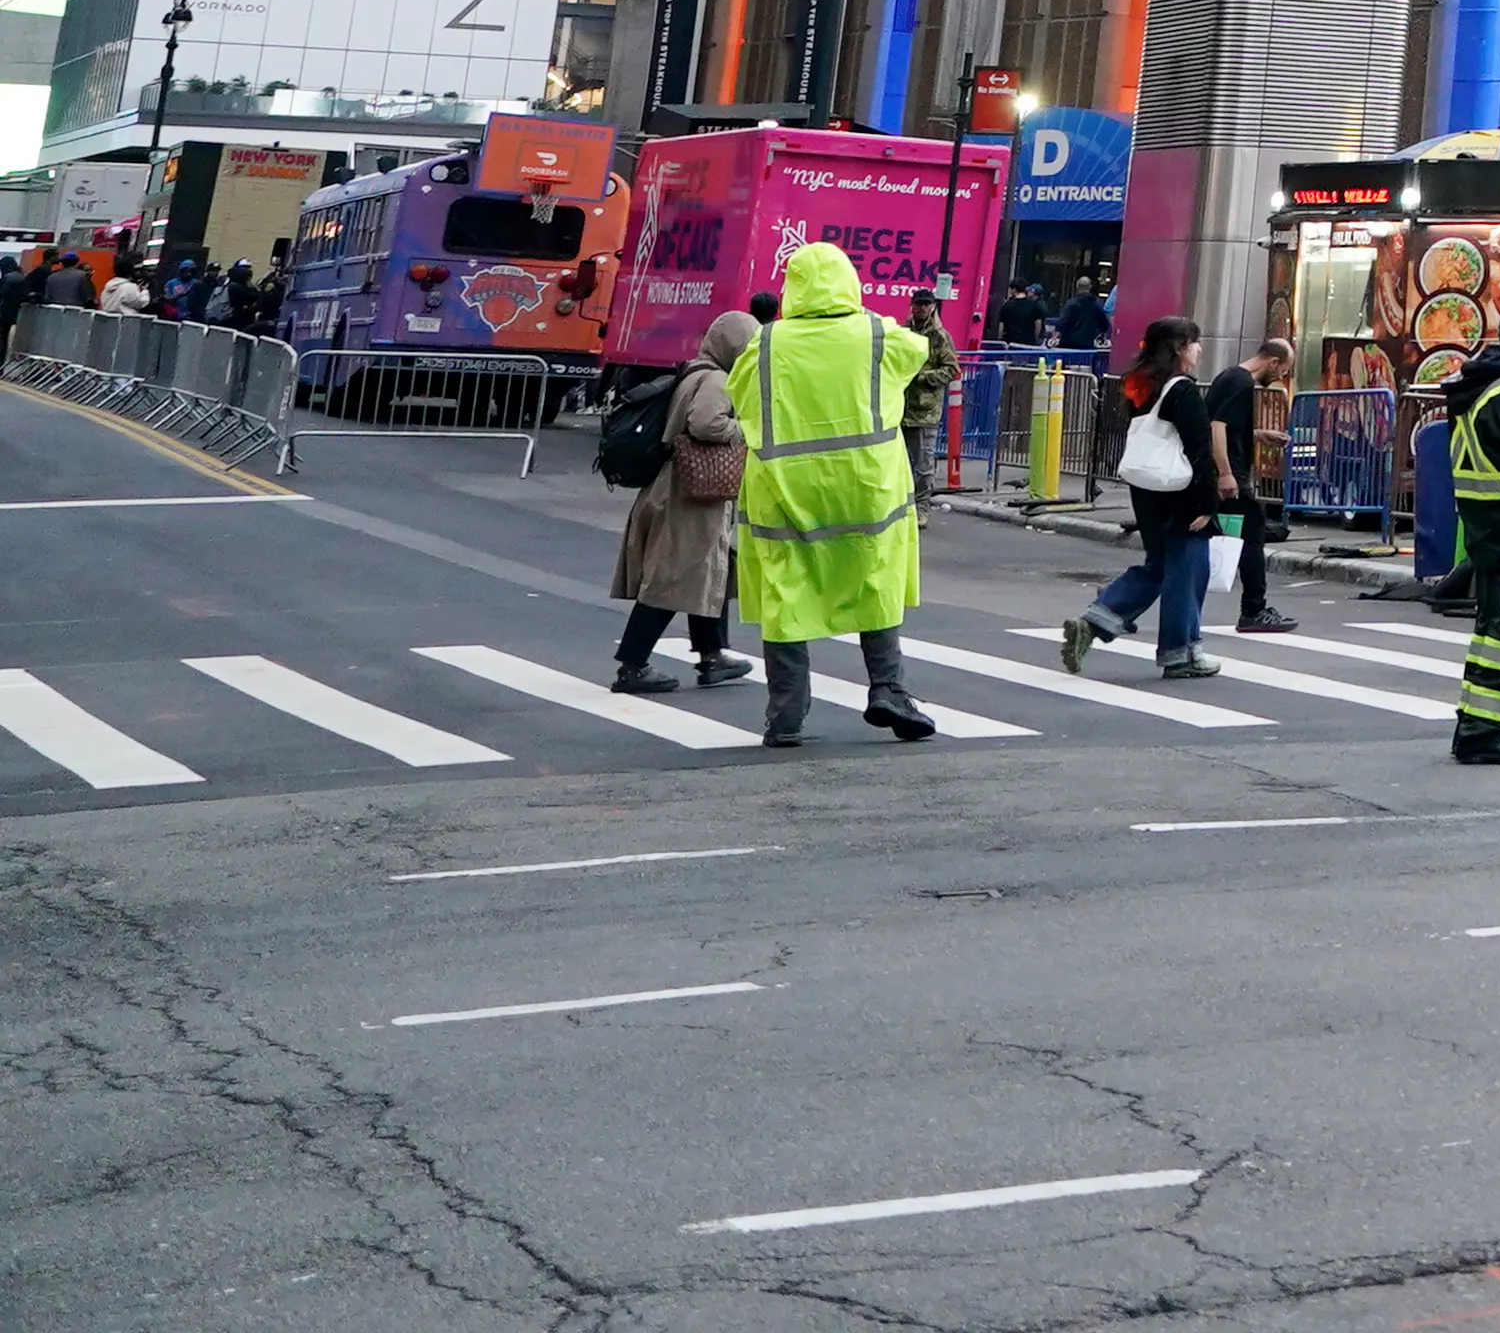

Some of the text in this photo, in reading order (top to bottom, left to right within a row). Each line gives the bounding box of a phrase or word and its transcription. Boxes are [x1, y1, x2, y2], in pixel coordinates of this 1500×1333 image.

[231, 149, 317, 167] NEW YORK
[1031, 129, 1070, 177] D
[520, 166, 569, 177] DOORDASH
[837, 175, 920, 195] most-loved
[1036, 185, 1124, 202] ENTRANCE
[821, 224, 916, 254] PIECE
[869, 255, 963, 284] CAKE
[647, 282, 675, 304] MOVING
[680, 282, 714, 305] STORAGE
[876, 282, 886, 295] &
[889, 284, 960, 300] STOE
[415, 358, 547, 373] CROSSTOWN EXPRESS
